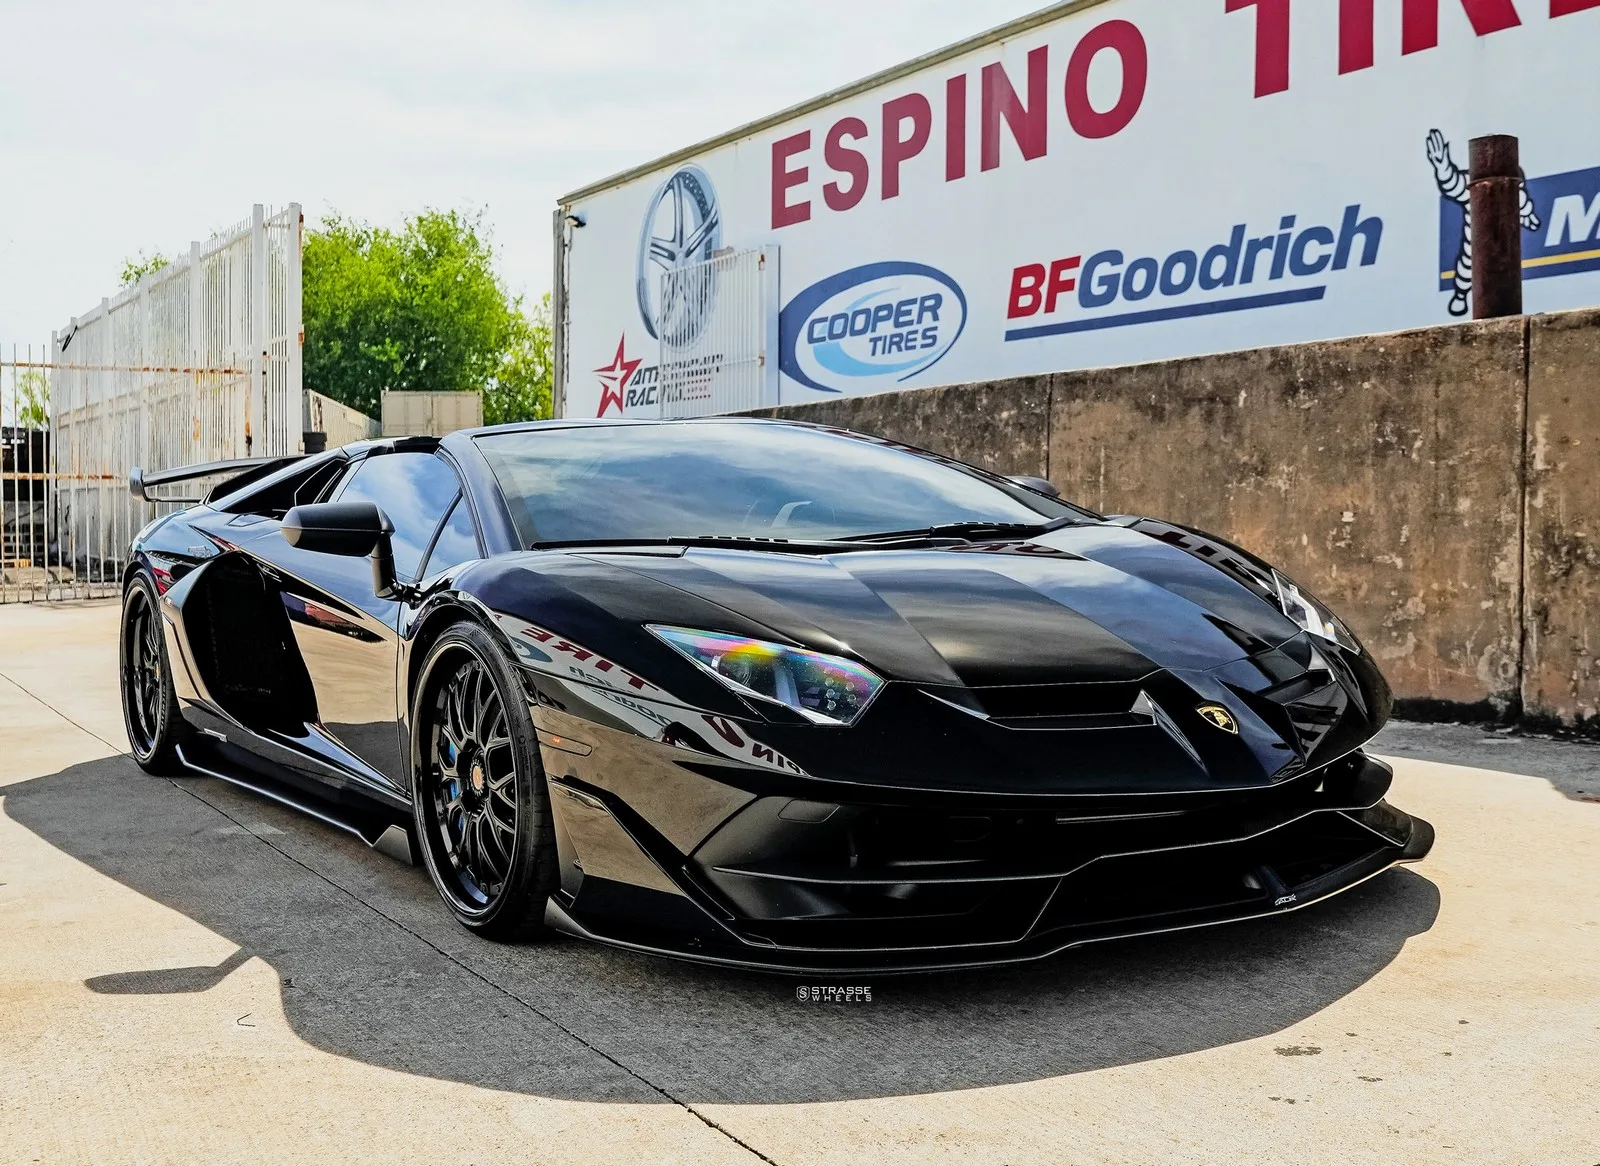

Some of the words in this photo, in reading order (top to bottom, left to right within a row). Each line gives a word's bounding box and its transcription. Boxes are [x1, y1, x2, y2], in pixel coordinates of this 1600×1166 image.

[771, 19, 1148, 230] ESPINO
[1007, 204, 1384, 320] BFGoodrich
[807, 293, 943, 345] COOPER
[869, 326, 939, 357] TIRES
